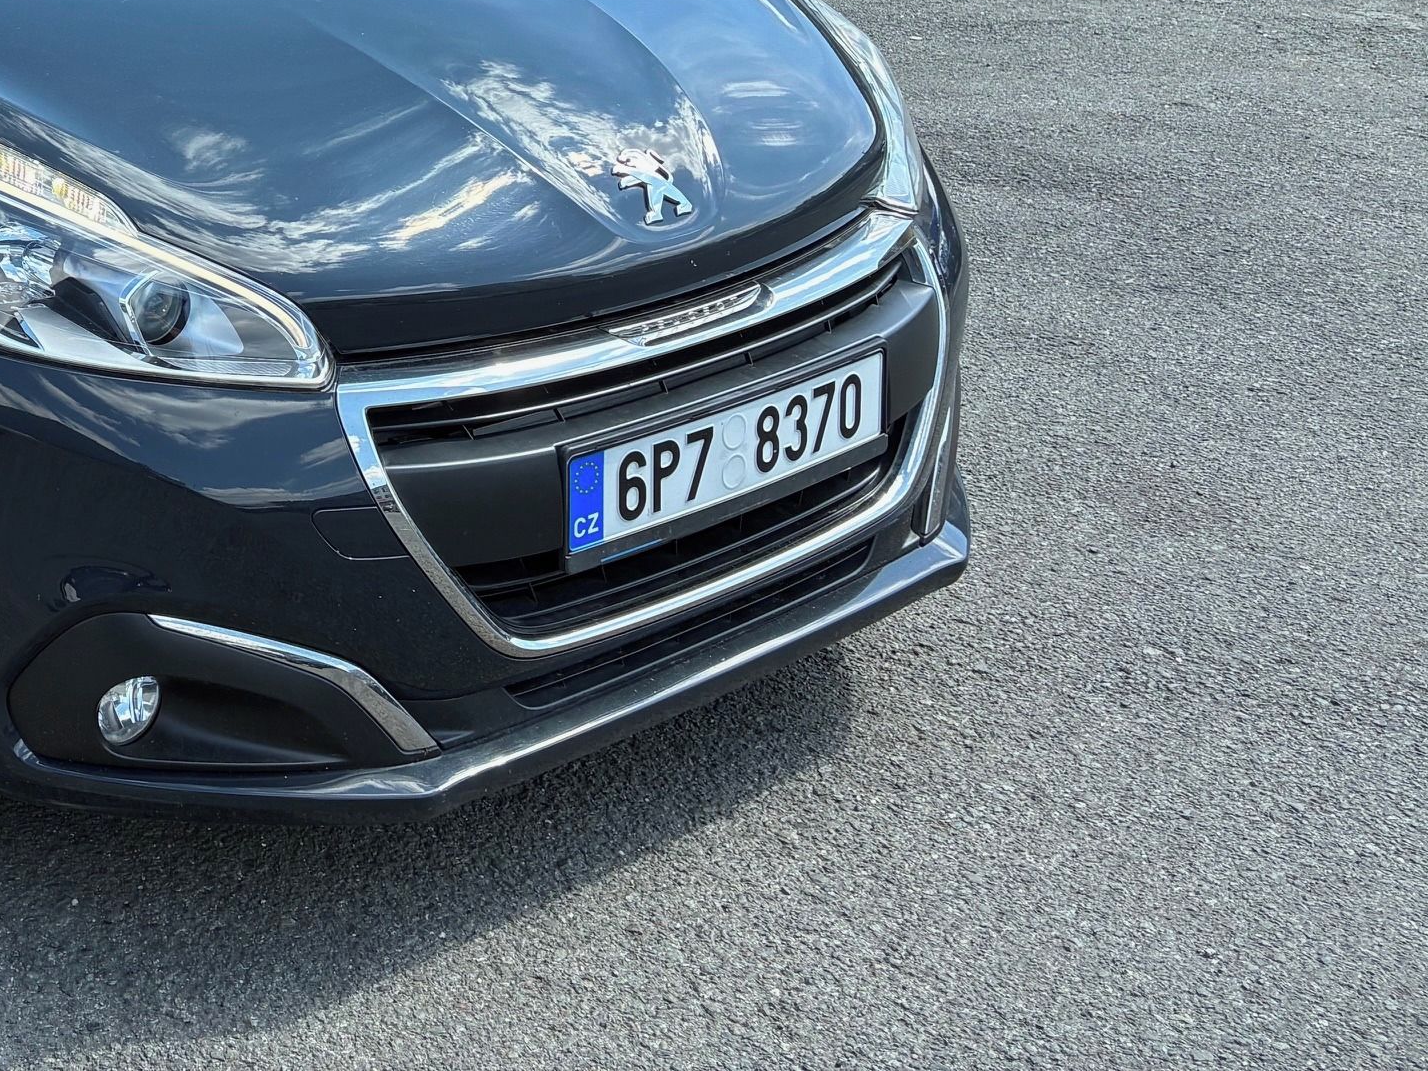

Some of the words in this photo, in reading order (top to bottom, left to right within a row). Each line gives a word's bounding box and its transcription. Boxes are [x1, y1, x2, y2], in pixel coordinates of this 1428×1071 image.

[618, 426, 715, 522] 6P7
[755, 373, 862, 474] 8370
[573, 512, 600, 539] CZ
